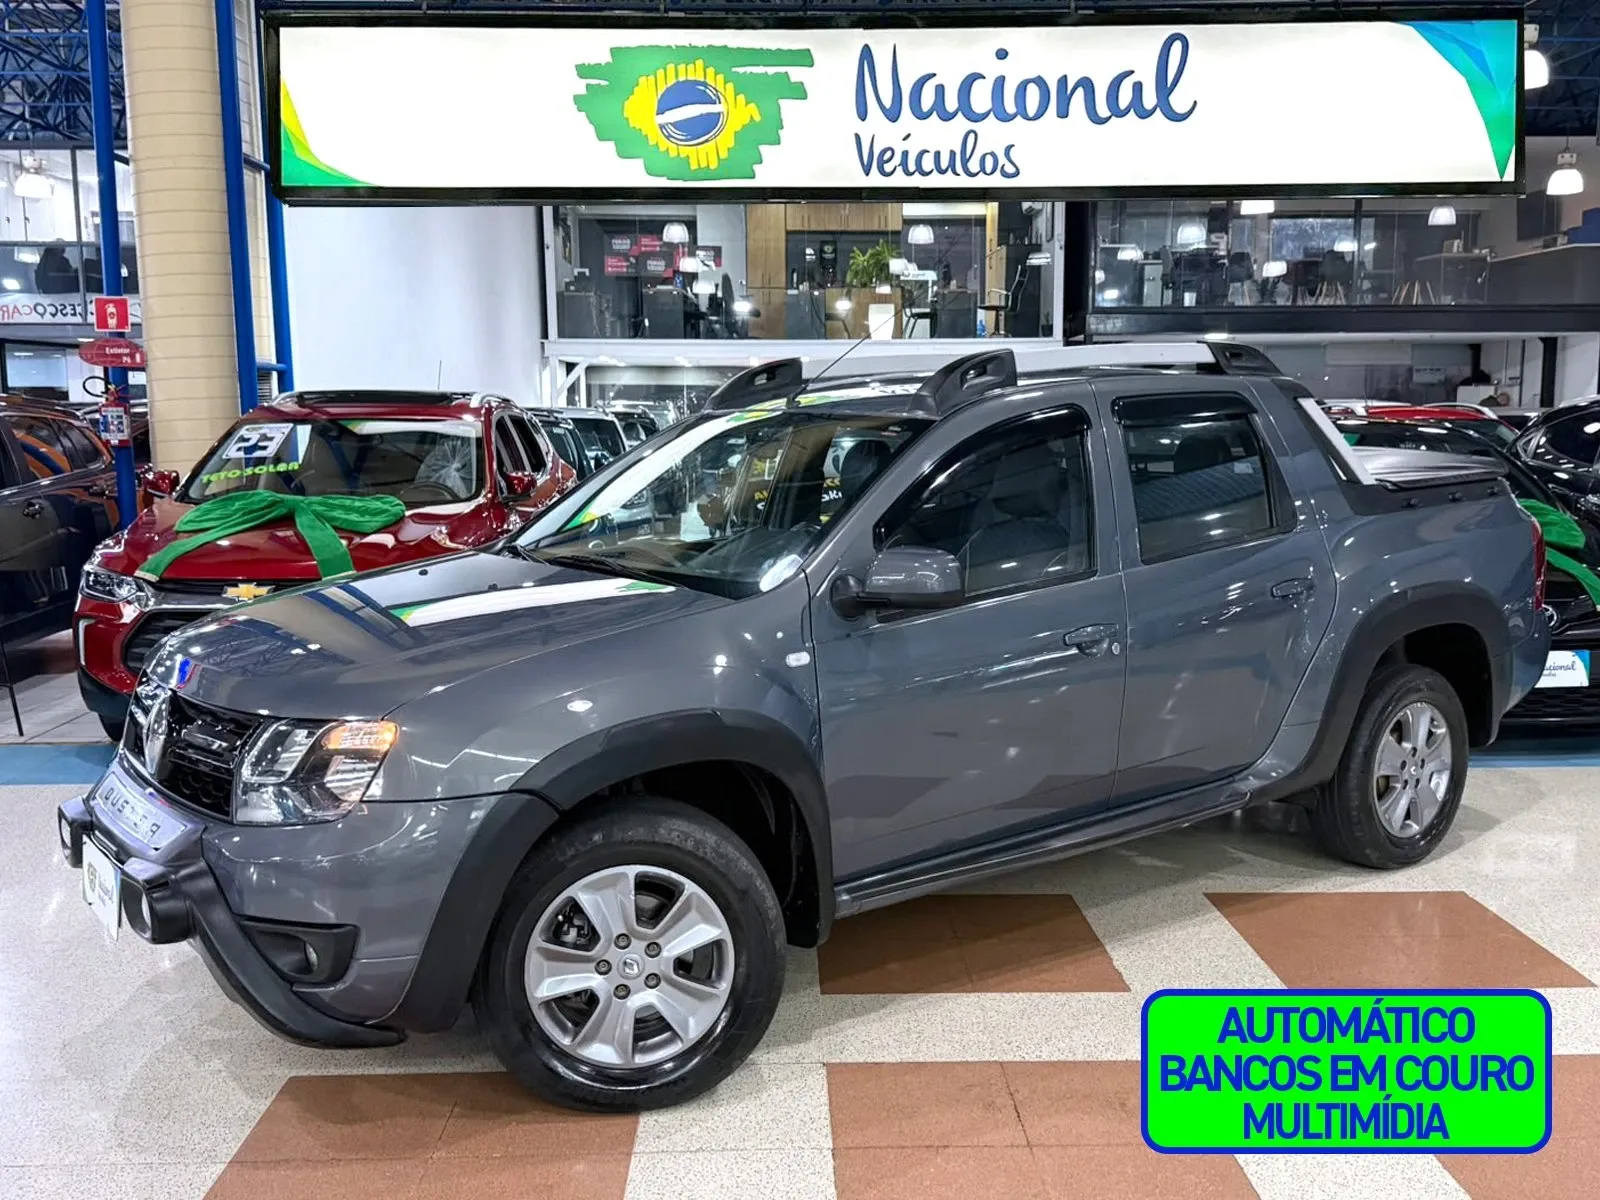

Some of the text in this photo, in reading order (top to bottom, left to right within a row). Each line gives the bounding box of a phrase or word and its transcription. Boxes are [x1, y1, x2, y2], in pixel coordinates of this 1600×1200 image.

[855, 32, 1198, 125] Nacional
[854, 129, 1020, 179] Veículos
[226, 432, 285, 457] 23
[202, 469, 241, 484] TETO
[1543, 660, 1577, 671] acional
